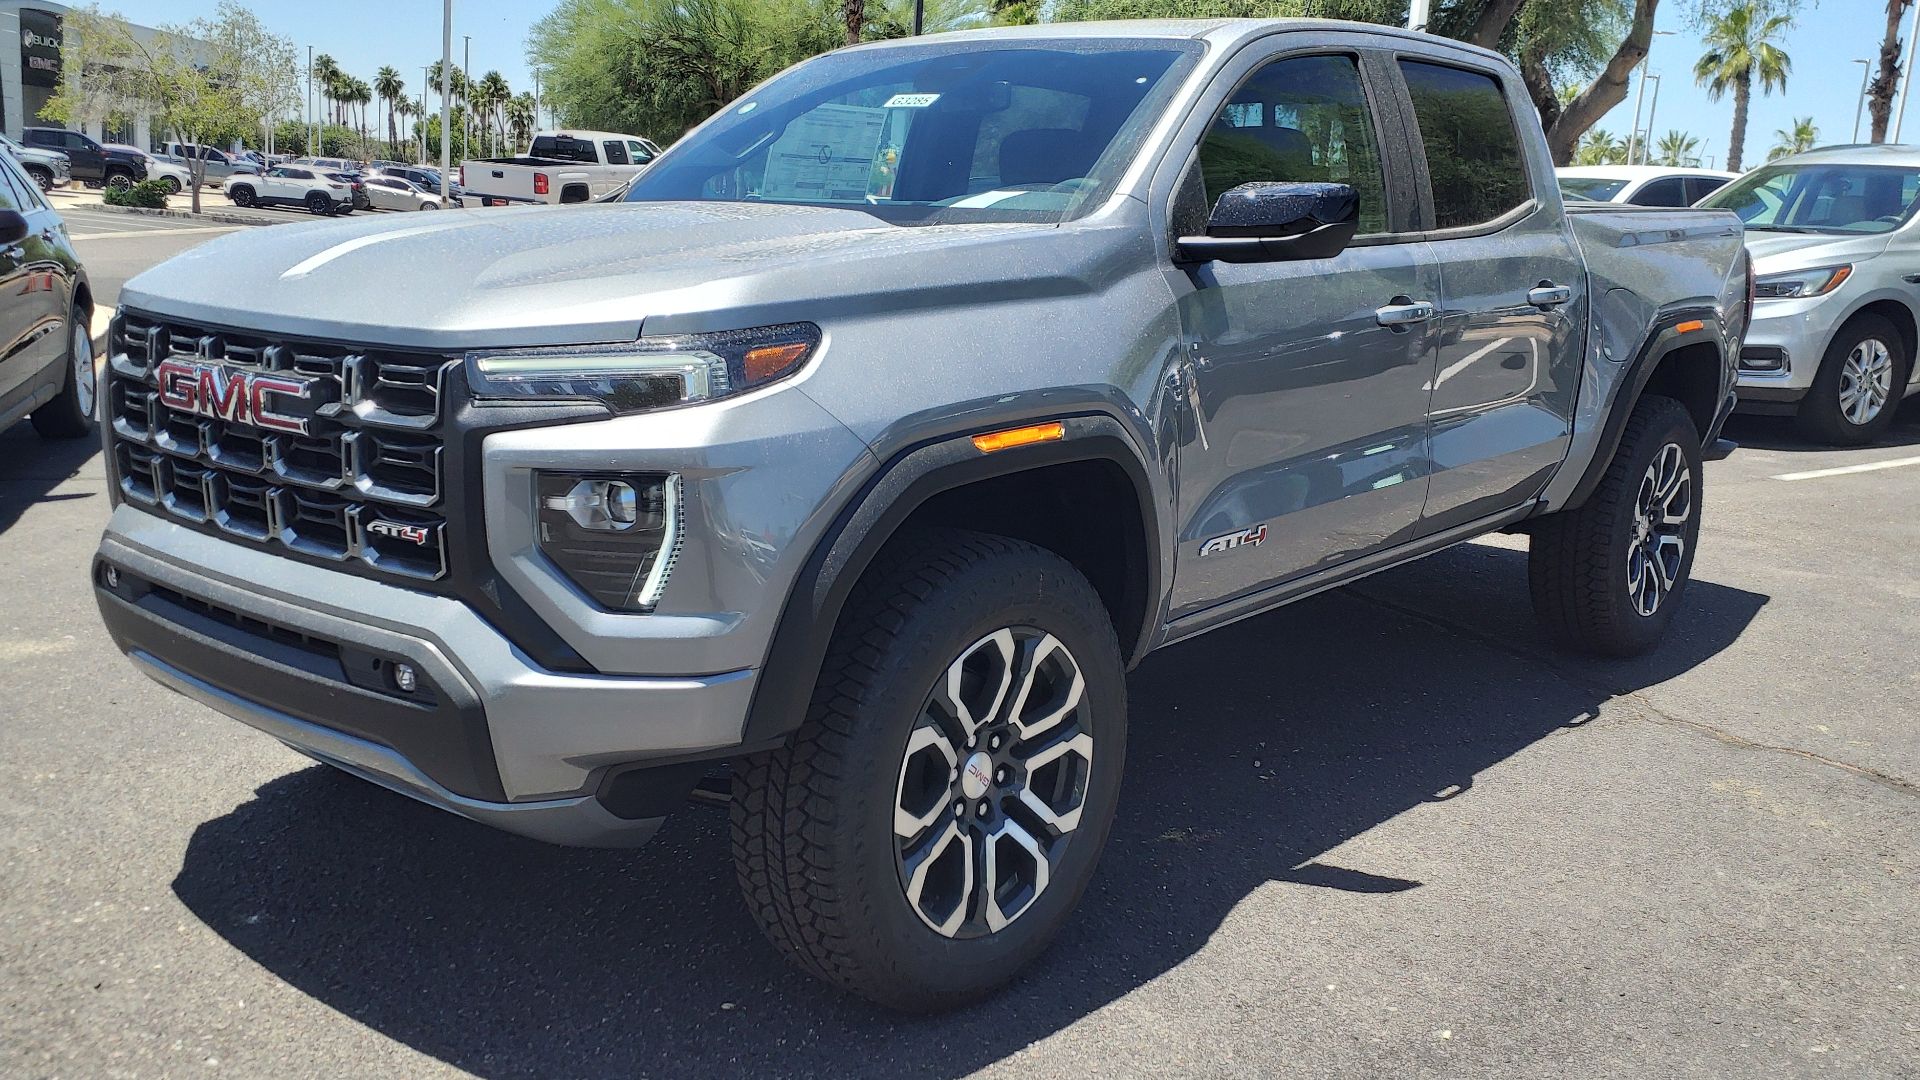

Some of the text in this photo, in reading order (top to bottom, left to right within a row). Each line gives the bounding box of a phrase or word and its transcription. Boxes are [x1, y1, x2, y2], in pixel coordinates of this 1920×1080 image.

[29, 56, 58, 71] GMC
[158, 355, 311, 436] GMC
[366, 519, 429, 546] AT4
[1198, 523, 1268, 557] AT4
[967, 763, 990, 788] GMC
